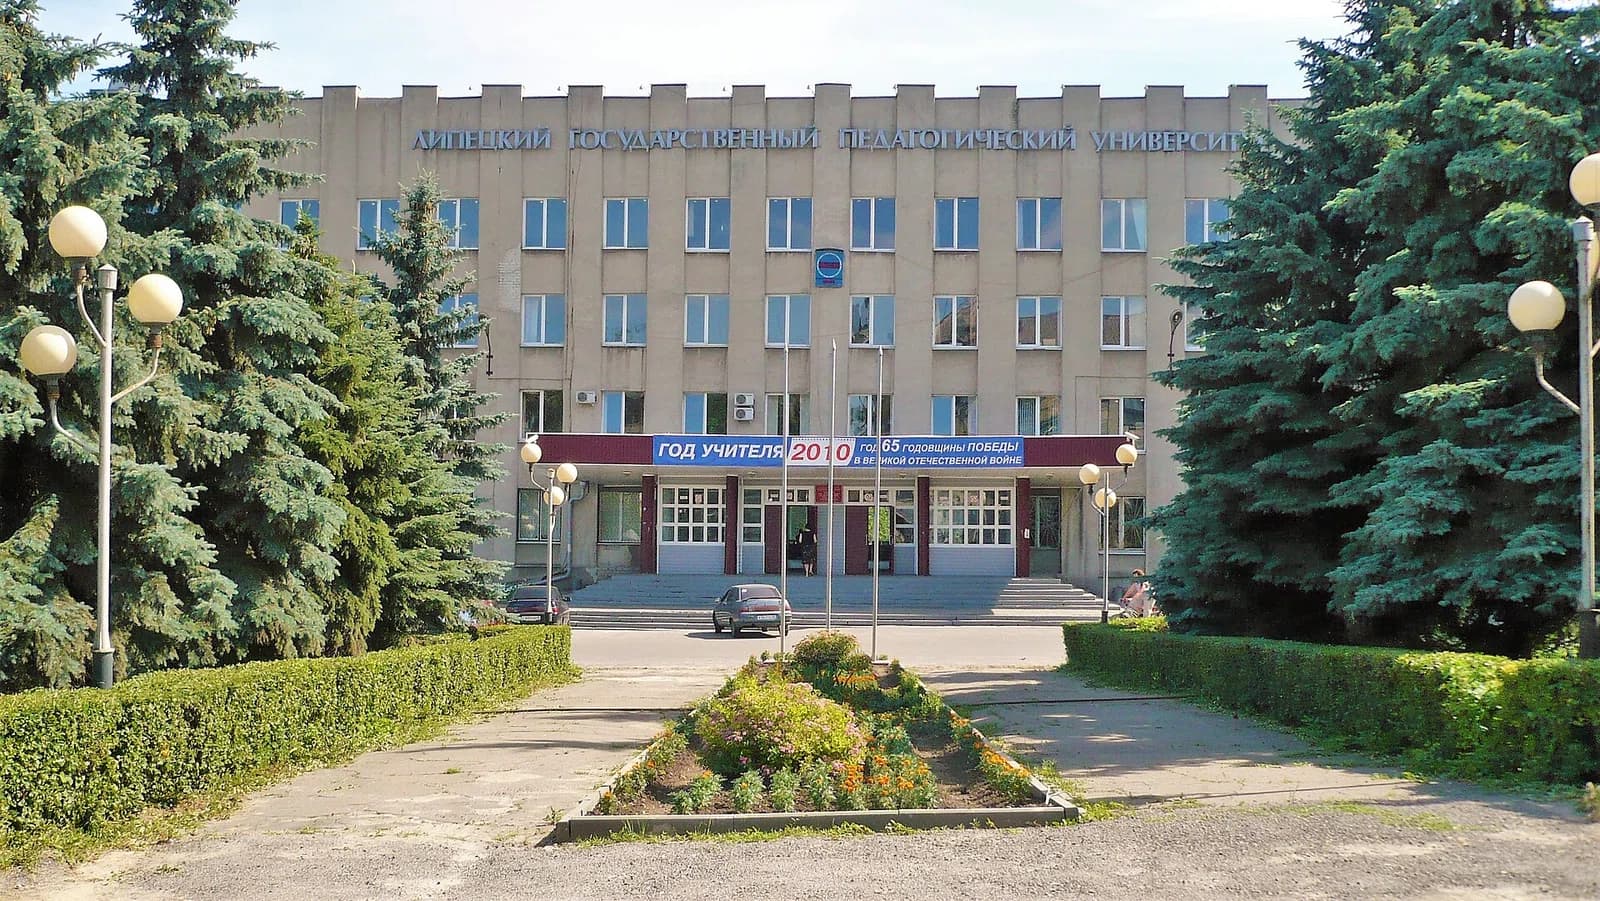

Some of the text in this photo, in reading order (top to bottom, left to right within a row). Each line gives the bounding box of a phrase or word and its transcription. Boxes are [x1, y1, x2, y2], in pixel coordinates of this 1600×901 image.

[412, 124, 1268, 153] ЛИПЕЦКИЙ ГОСУДАРСТВЕННЫЙ ПЕДАГОГИЧЕСКИЙ УНИВЕРСИТ
[658, 443, 784, 460] ГОД УЧИТЕЛЯ
[791, 443, 851, 461] 2010
[882, 439, 900, 452] 65
[902, 443, 965, 453] ГОДОВЩИНЫ
[967, 441, 1019, 453] ПОБЕДЫ
[853, 454, 1022, 465] В ВЕИКОЙ ОТЕЧЕСТВЕННОЙ ВОЙНЕ
